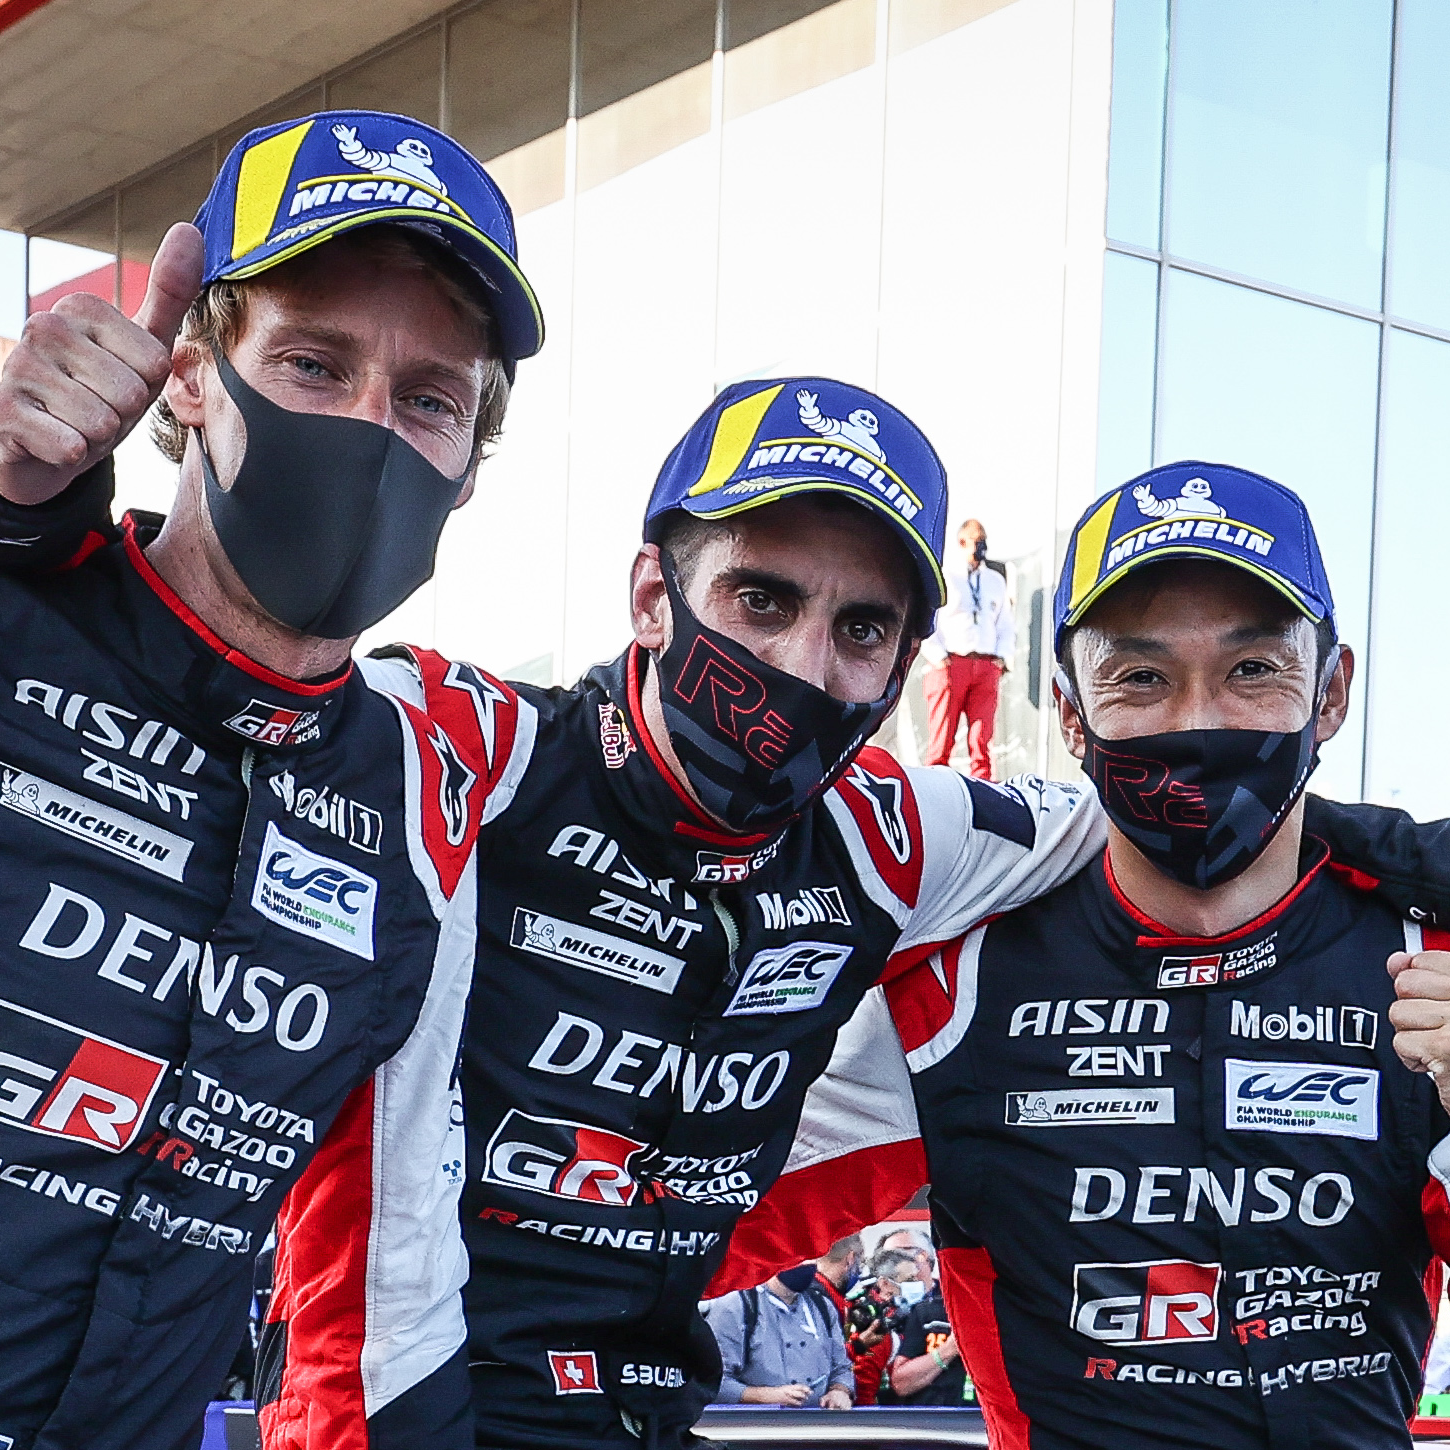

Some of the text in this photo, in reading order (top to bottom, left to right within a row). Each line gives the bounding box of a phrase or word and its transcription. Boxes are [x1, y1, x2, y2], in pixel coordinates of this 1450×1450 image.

[748, 444, 921, 522] MICHELIN
[1107, 521, 1274, 571] MICHELIN
[14, 679, 208, 776] AISIN
[230, 715, 288, 743] GR
[80, 747, 200, 820] ZENT
[269, 769, 346, 838] Mobil
[44, 801, 171, 861] MICHELIN
[265, 851, 369, 914] WEC
[697, 864, 747, 881] GR
[271, 889, 303, 912] WORLD
[302, 904, 357, 936] ENDURANCE
[589, 889, 703, 950] ZENT
[18, 882, 330, 1052] DENSO
[559, 936, 666, 978] MICHELIN
[1224, 931, 1279, 961] TOYOTA
[1224, 943, 1275, 971] GAZOO
[1224, 954, 1277, 982] Racing
[744, 949, 843, 989] WEC
[1161, 966, 1217, 986] GR
[1009, 998, 1171, 1037] AISIN
[1231, 1000, 1335, 1043] Mobil
[528, 1011, 790, 1113] DENSO
[1066, 1045, 1172, 1077] ZENT
[175, 1061, 316, 1144] TOYOTA
[1053, 1099, 1160, 1115] MICHELIN
[1236, 1072, 1370, 1104] WEC
[160, 1102, 297, 1170] GAZOO
[1236, 1105, 1358, 1123] FIA WORLD ENDURANCE
[1236, 1115, 1317, 1128] CHAMPIONSHIP
[137, 1132, 277, 1202] Racing
[492, 1141, 635, 1205] GR
[1069, 1166, 1354, 1227] DENSO
[478, 1206, 654, 1251] RACING
[1235, 1266, 1381, 1294] TOYOTA
[1076, 1292, 1214, 1341] GR
[1231, 1310, 1368, 1345] Racing
[1084, 1352, 1392, 1396] RACING HYBRID
